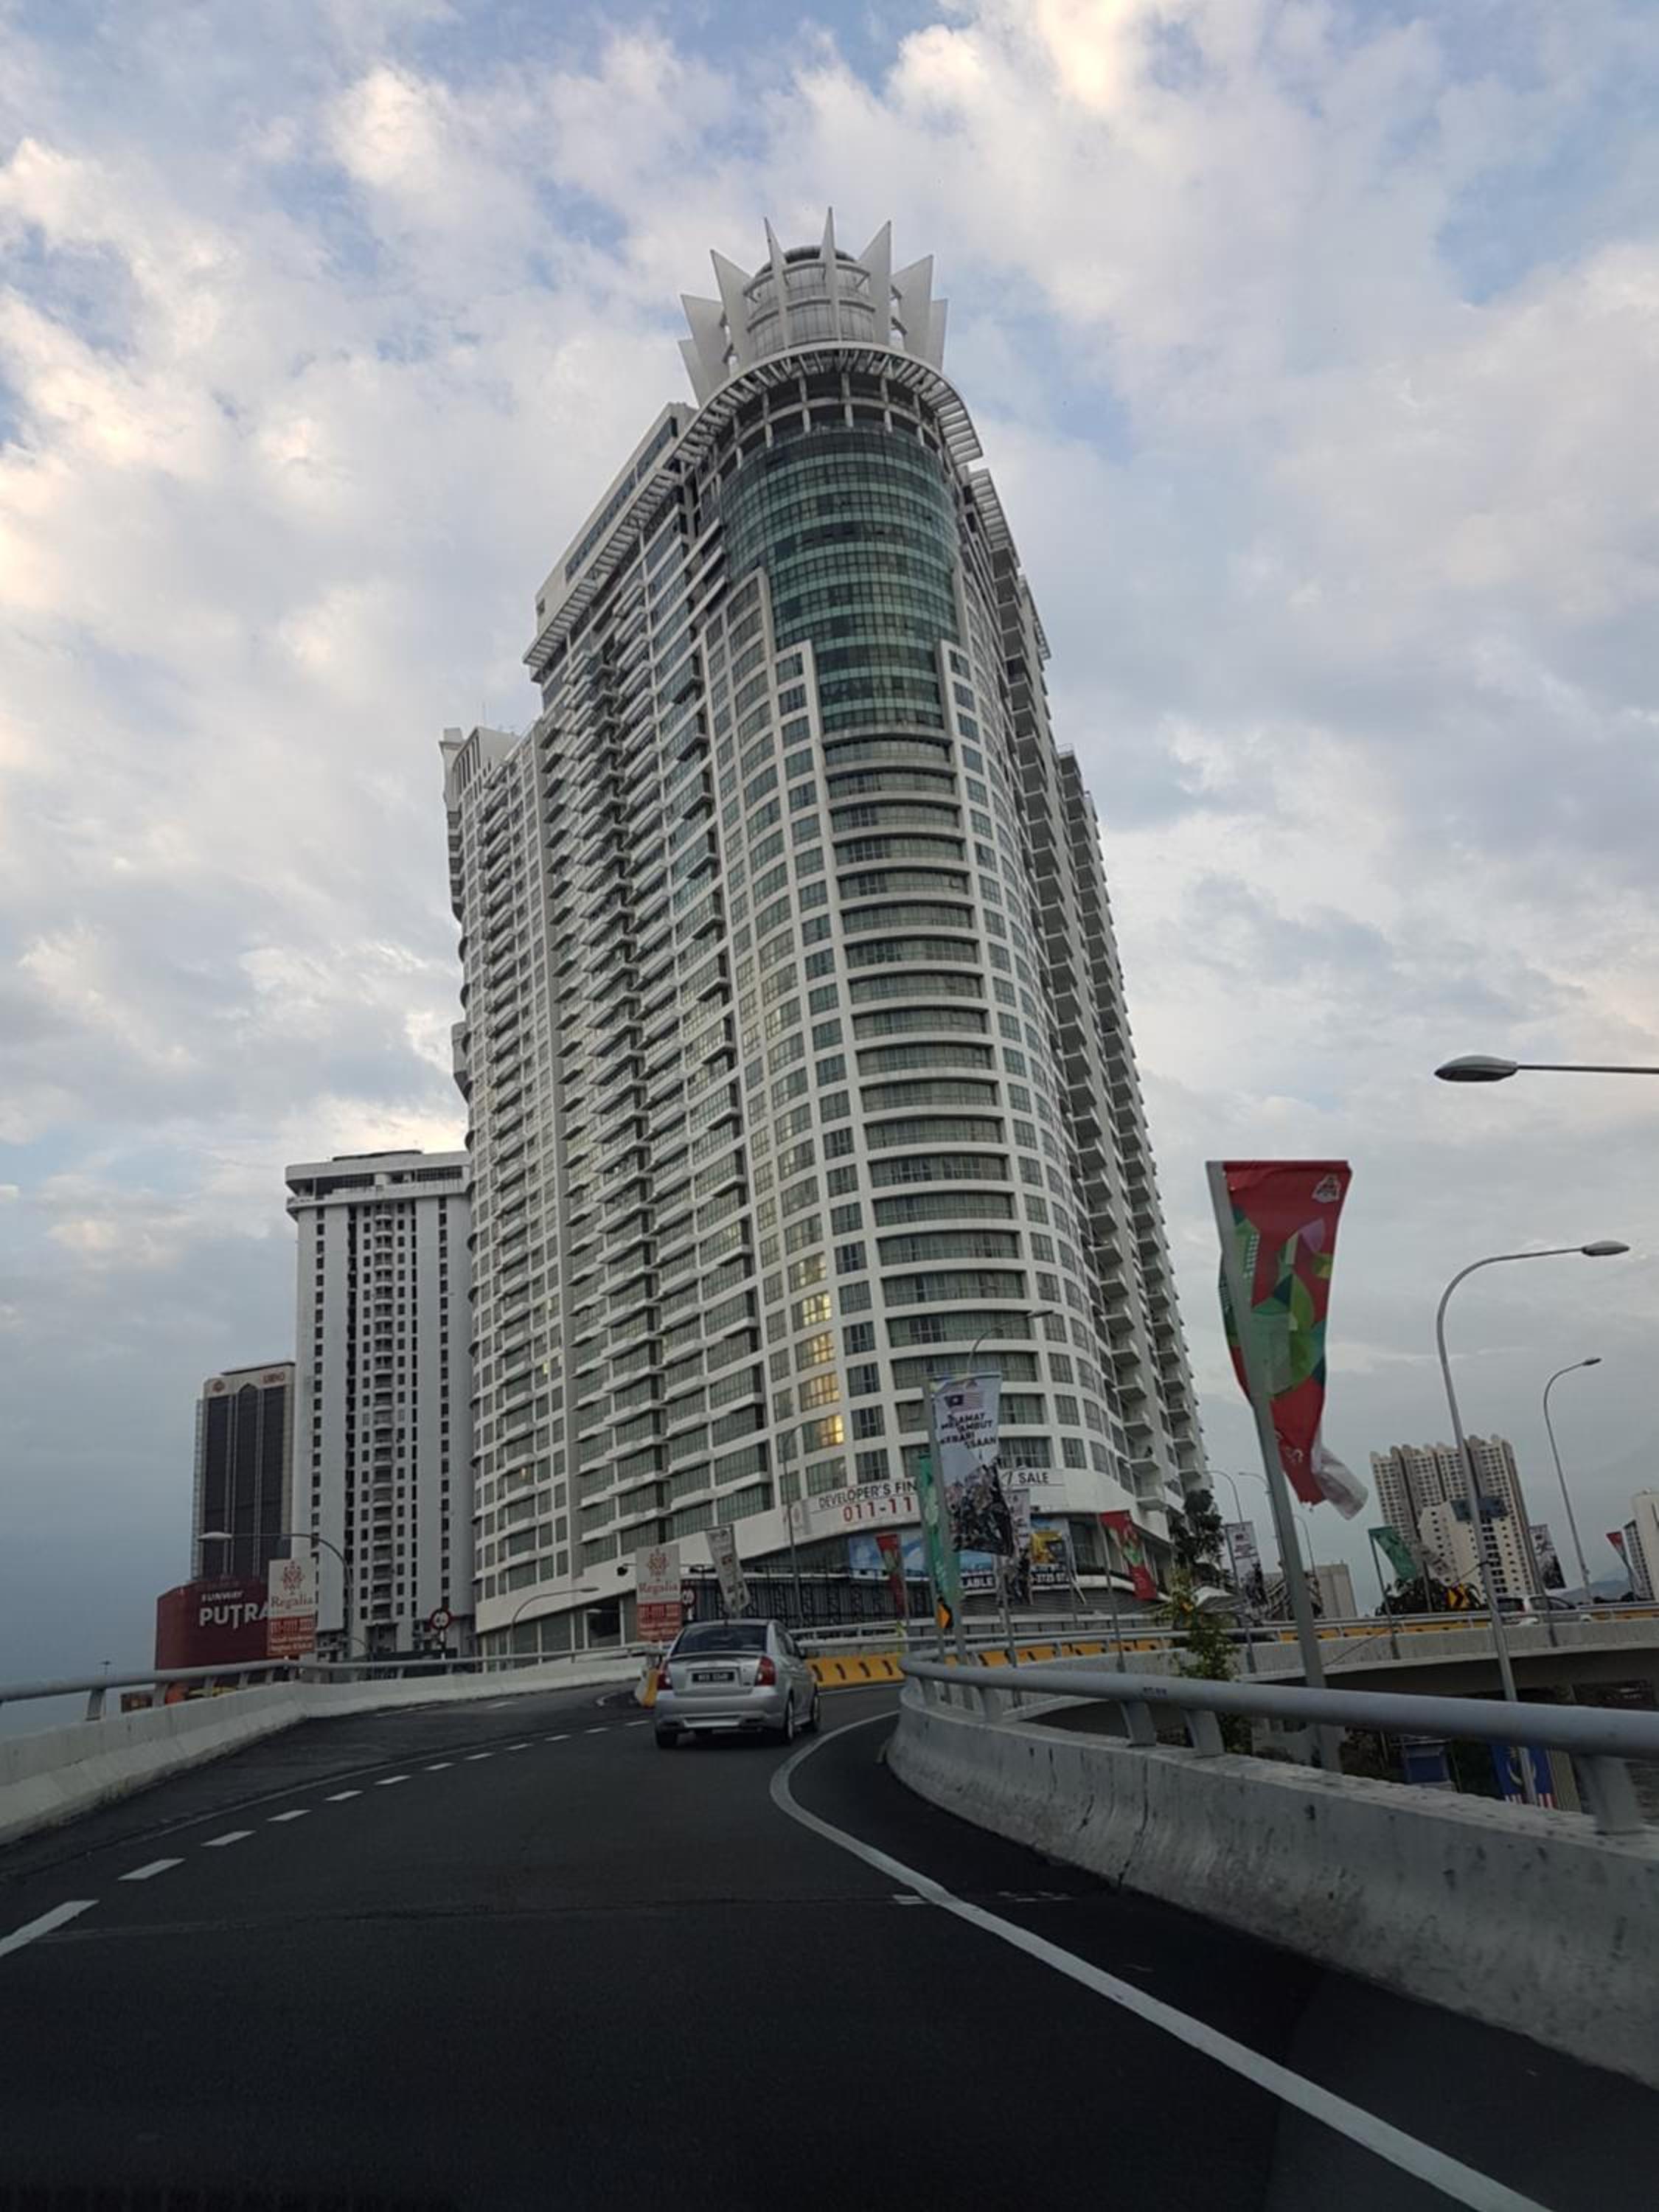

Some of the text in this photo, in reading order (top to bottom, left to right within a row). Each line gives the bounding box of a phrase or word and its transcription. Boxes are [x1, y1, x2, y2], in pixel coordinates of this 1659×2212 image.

[818, 1483, 891, 1510] DEVELOPER'S
[1018, 1472, 1048, 1484] SALE
[844, 1496, 912, 1522] 011-11
[271, 1593, 313, 1609] Regalia
